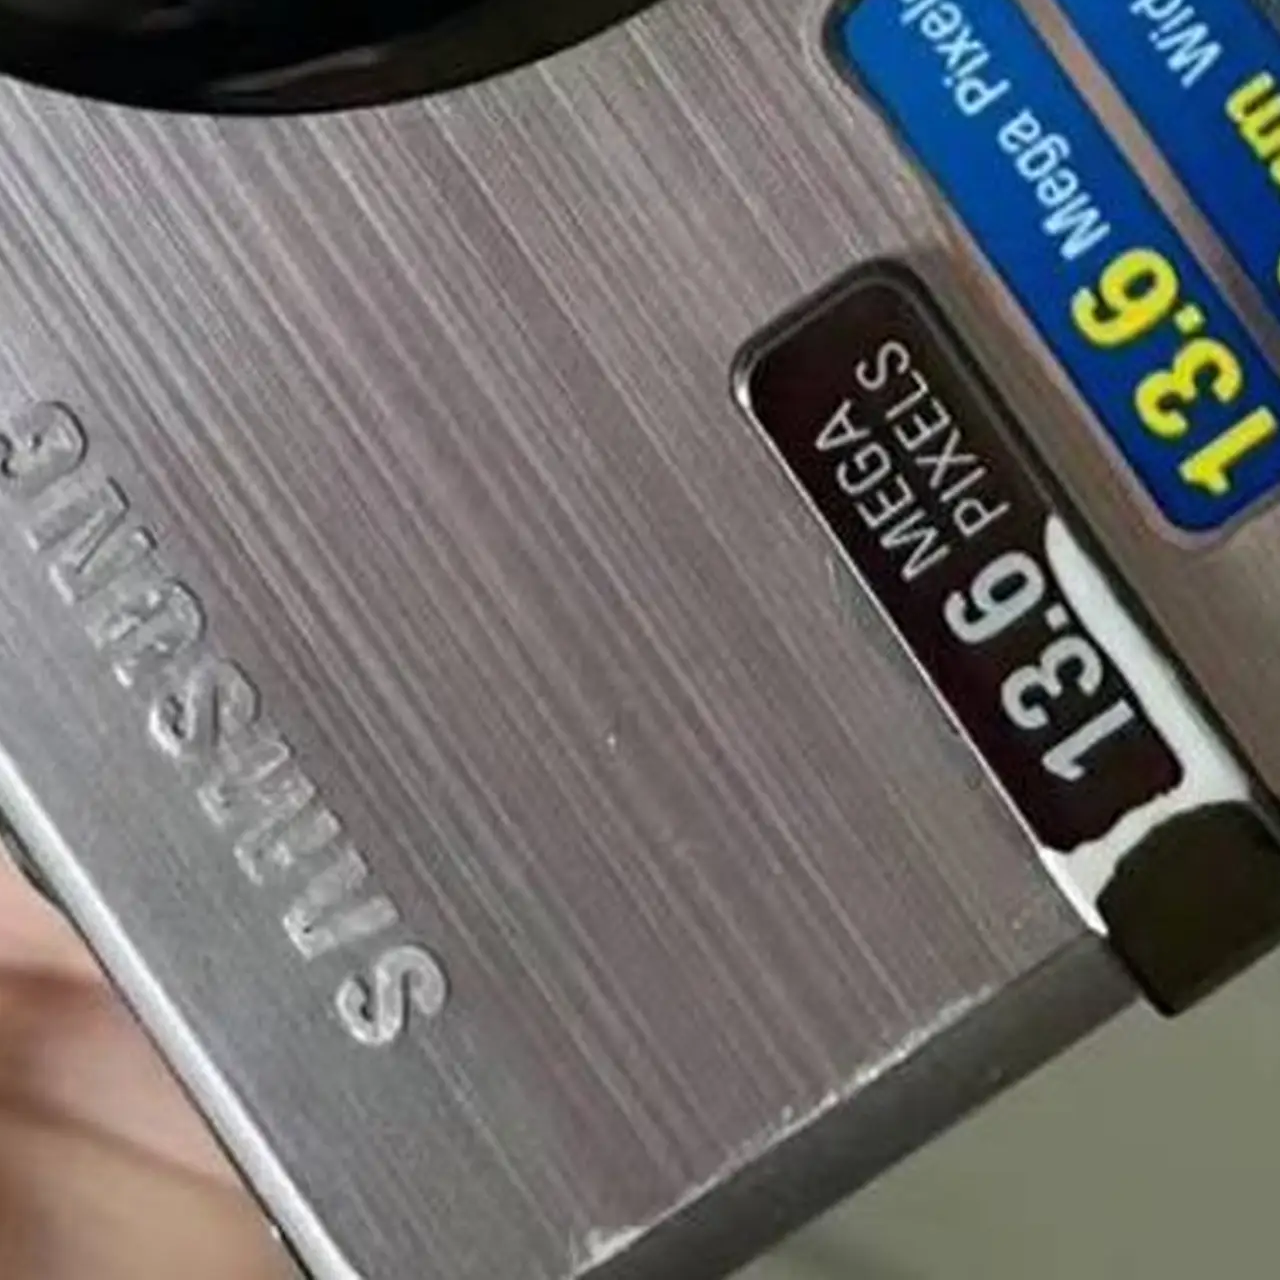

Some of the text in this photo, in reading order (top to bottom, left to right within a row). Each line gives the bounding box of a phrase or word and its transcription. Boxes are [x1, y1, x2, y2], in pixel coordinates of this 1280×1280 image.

[996, 107, 1112, 262] Mega
[855, 339, 1011, 539] PIXELS
[1070, 247, 1279, 495] 13.6
[814, 399, 951, 582] MEGA
[942, 550, 1136, 782] 13.6
